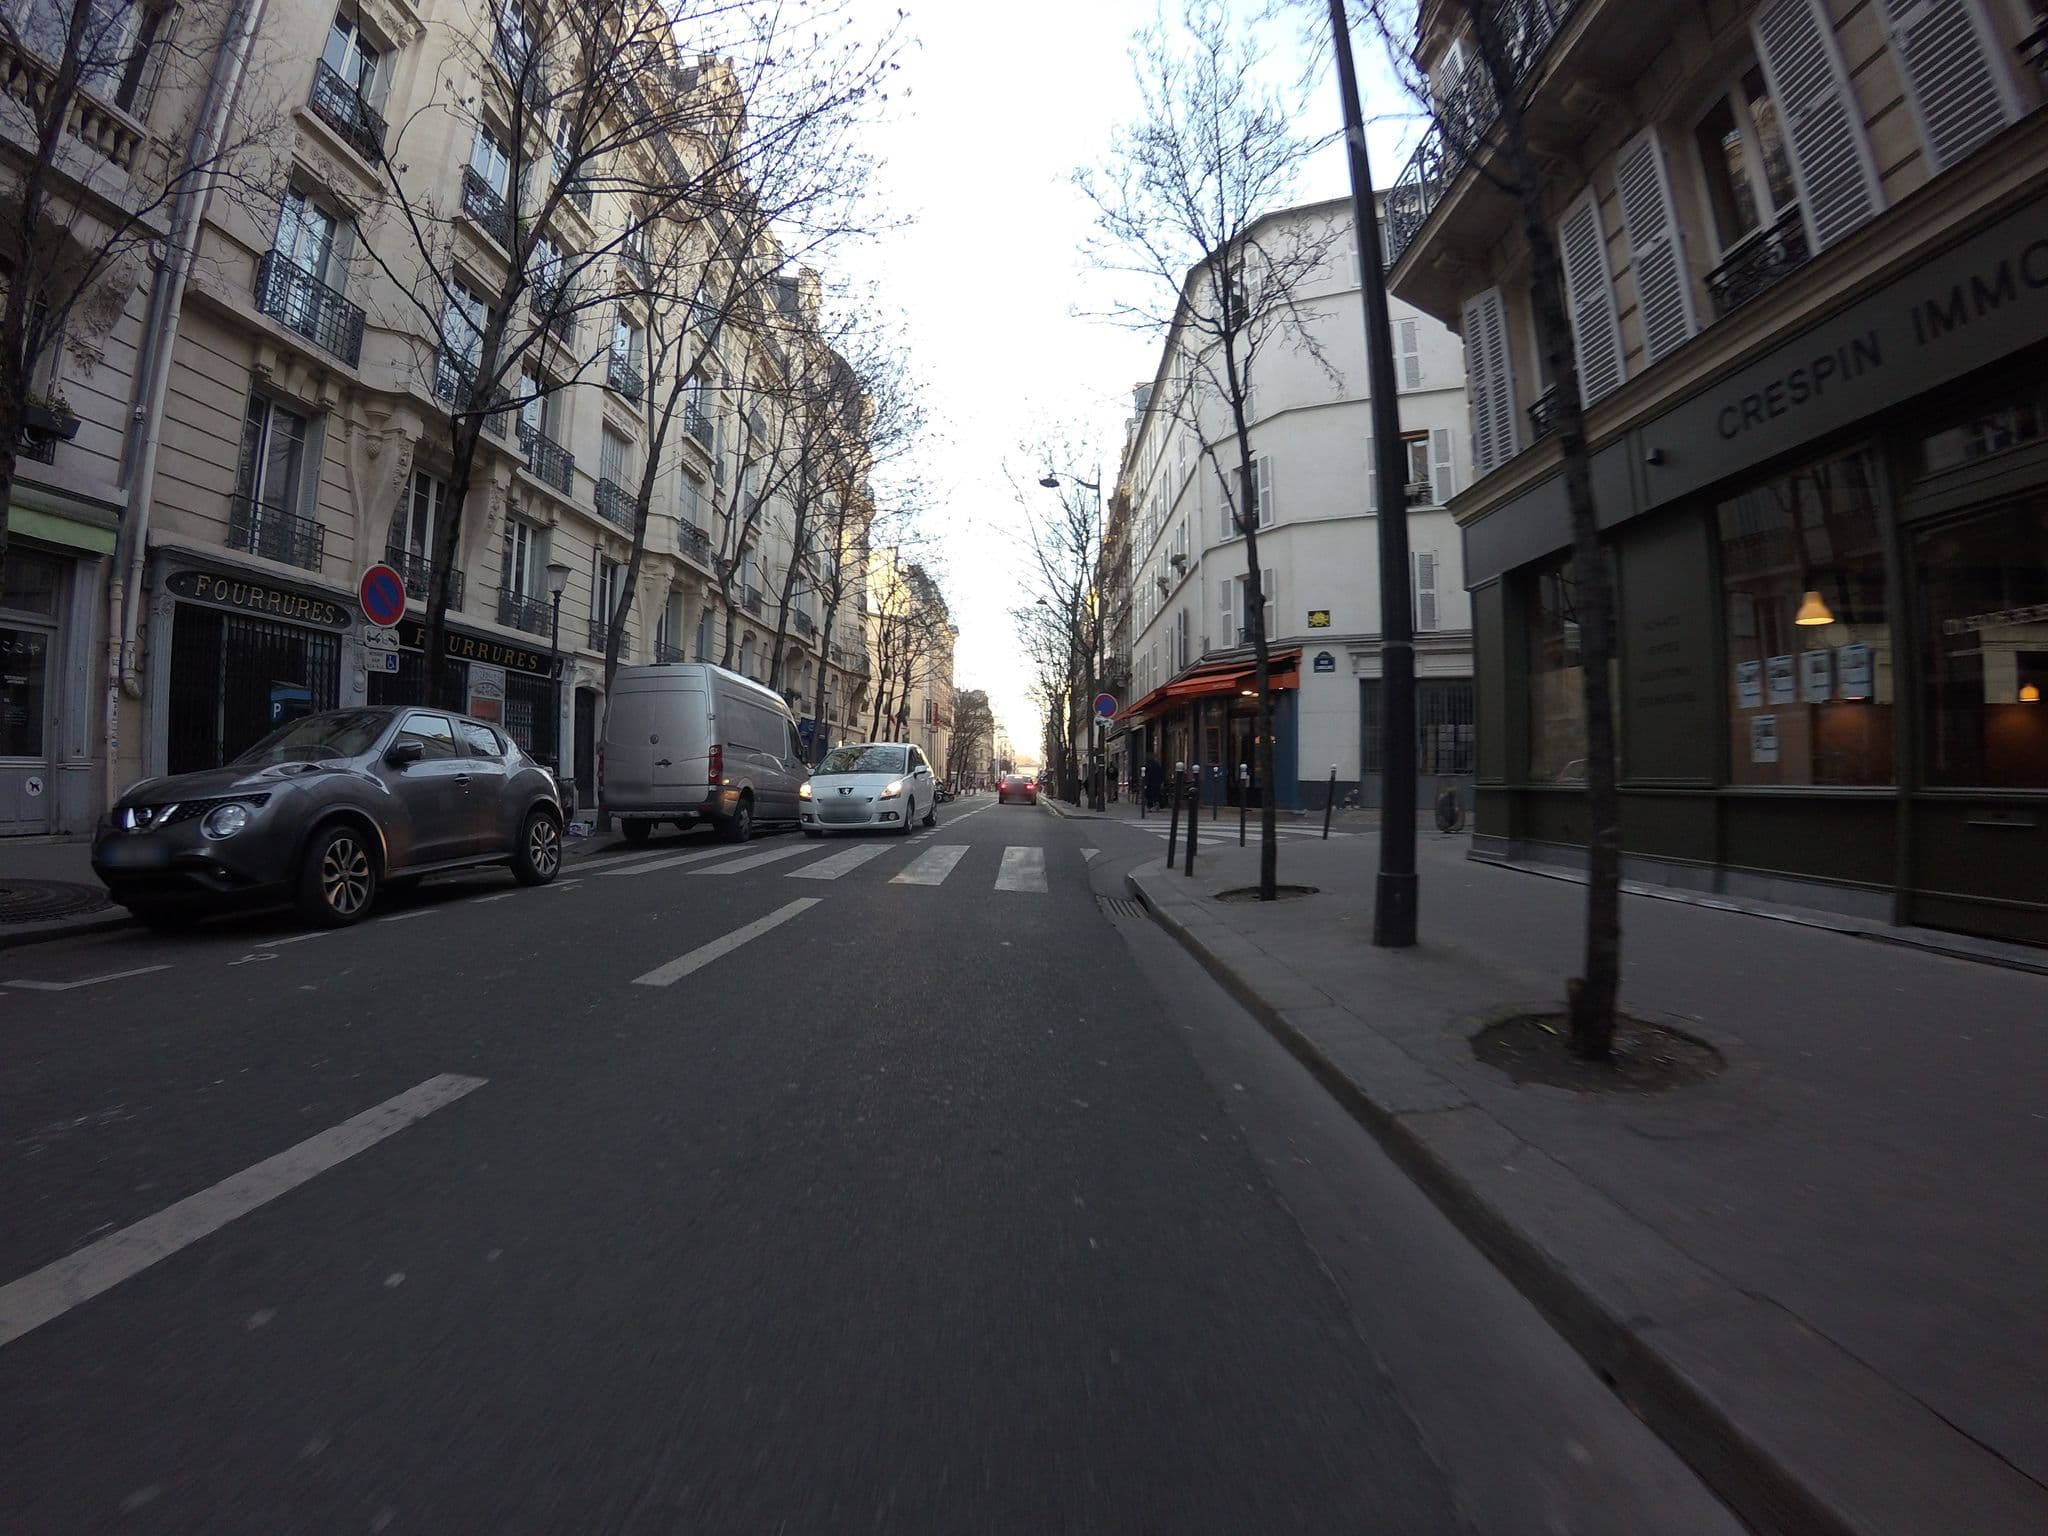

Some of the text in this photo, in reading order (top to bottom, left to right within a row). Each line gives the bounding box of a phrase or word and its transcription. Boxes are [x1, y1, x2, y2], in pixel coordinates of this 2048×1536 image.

[1717, 330, 1882, 440] CRESPIN
[194, 574, 336, 624] FOURRURES
[414, 627, 539, 670] FURRURES
[273, 702, 282, 719] P
